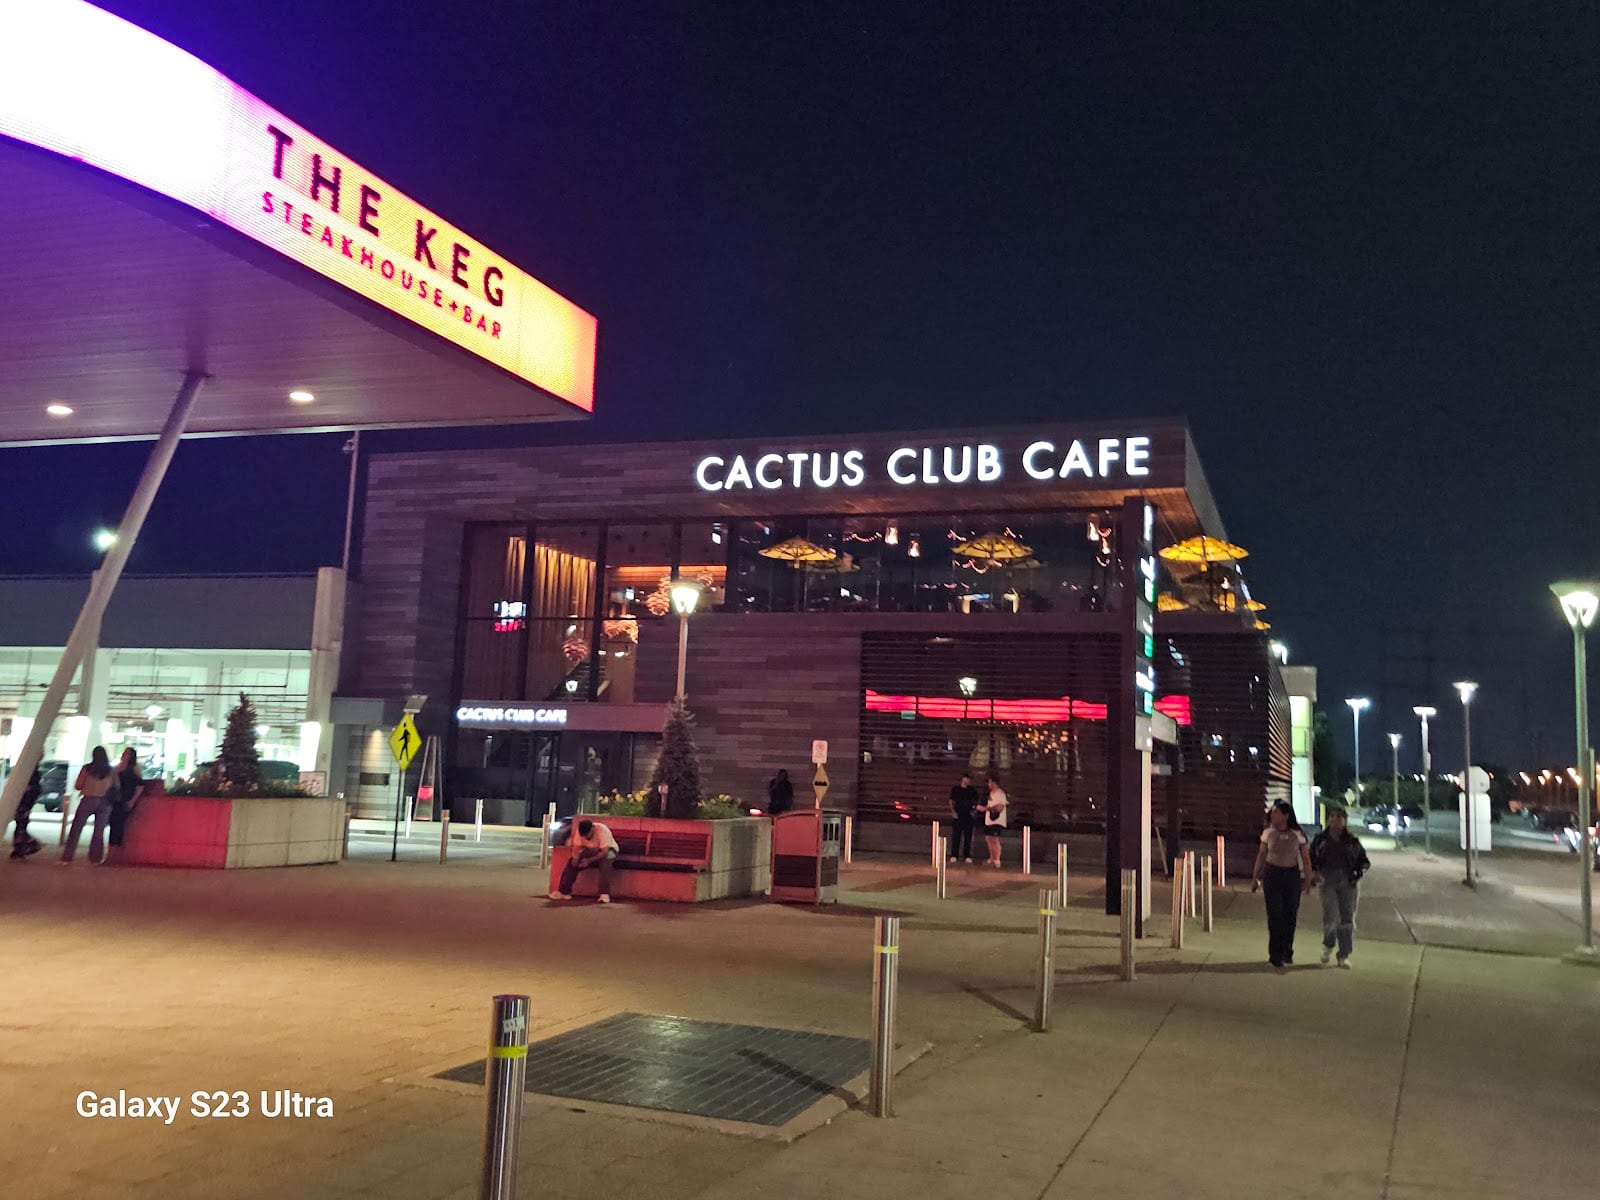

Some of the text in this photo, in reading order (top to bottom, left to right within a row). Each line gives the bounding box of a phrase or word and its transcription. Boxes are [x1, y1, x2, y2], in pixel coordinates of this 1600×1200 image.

[266, 124, 504, 307] THE KEG
[696, 436, 1151, 492] CACTUS CLUB CAFE
[456, 706, 568, 723] CACTUS CLUB CAFE
